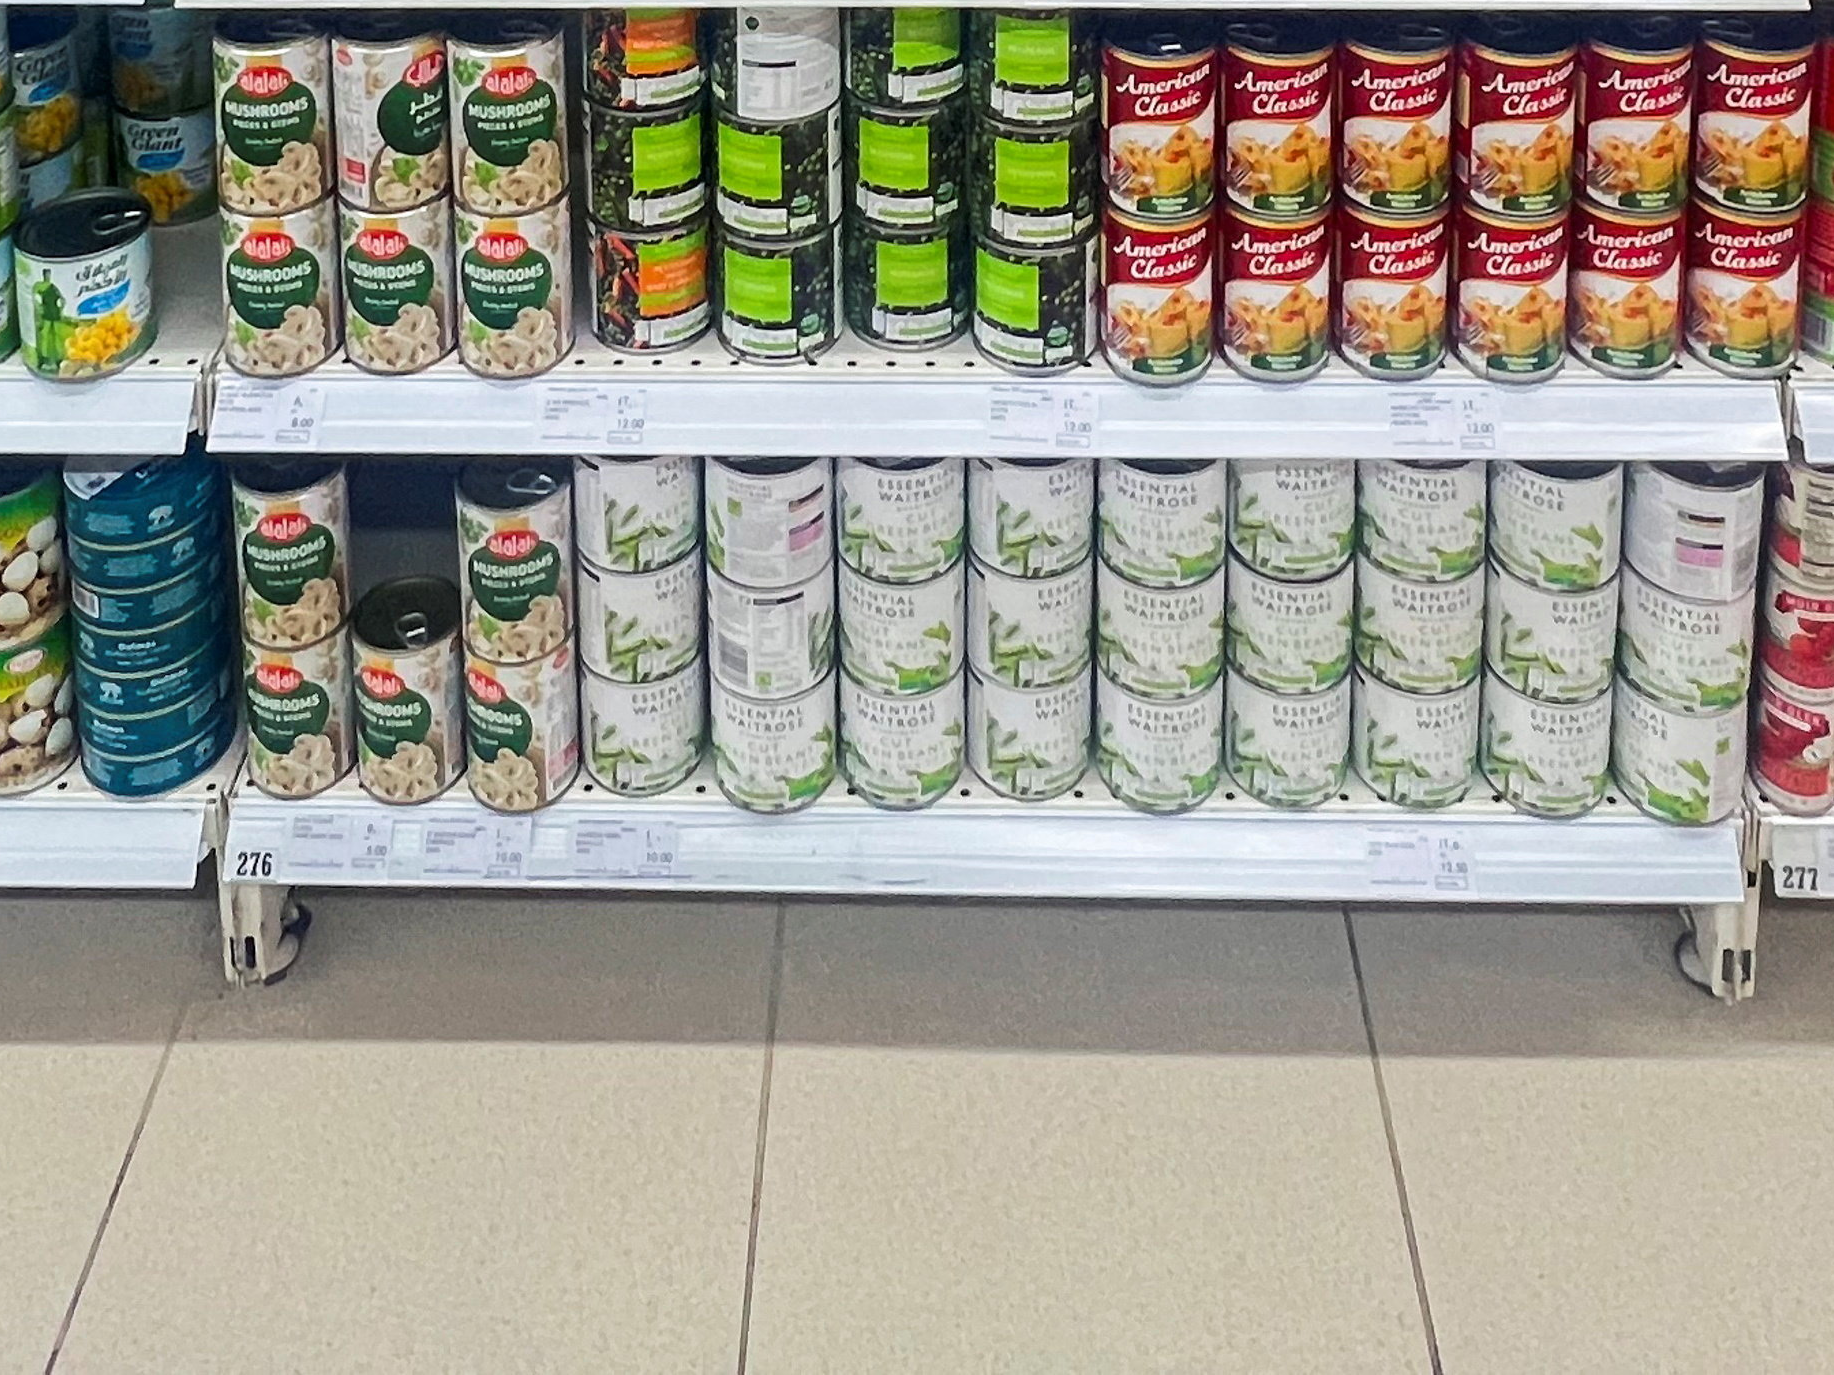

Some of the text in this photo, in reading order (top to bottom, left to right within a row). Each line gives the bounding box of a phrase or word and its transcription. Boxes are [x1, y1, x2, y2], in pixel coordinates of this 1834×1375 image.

[1116, 63, 1210, 94] American
[1706, 60, 1808, 94] American
[225, 96, 308, 118] MUSHROOMS
[468, 94, 551, 119] MUSHROOMS
[1134, 88, 1203, 118] Classic
[1723, 83, 1797, 111] Classic
[1350, 223, 1444, 255] American
[1367, 250, 1436, 276] Classic
[236, 851, 273, 877] 276
[1782, 865, 1819, 892] 277
